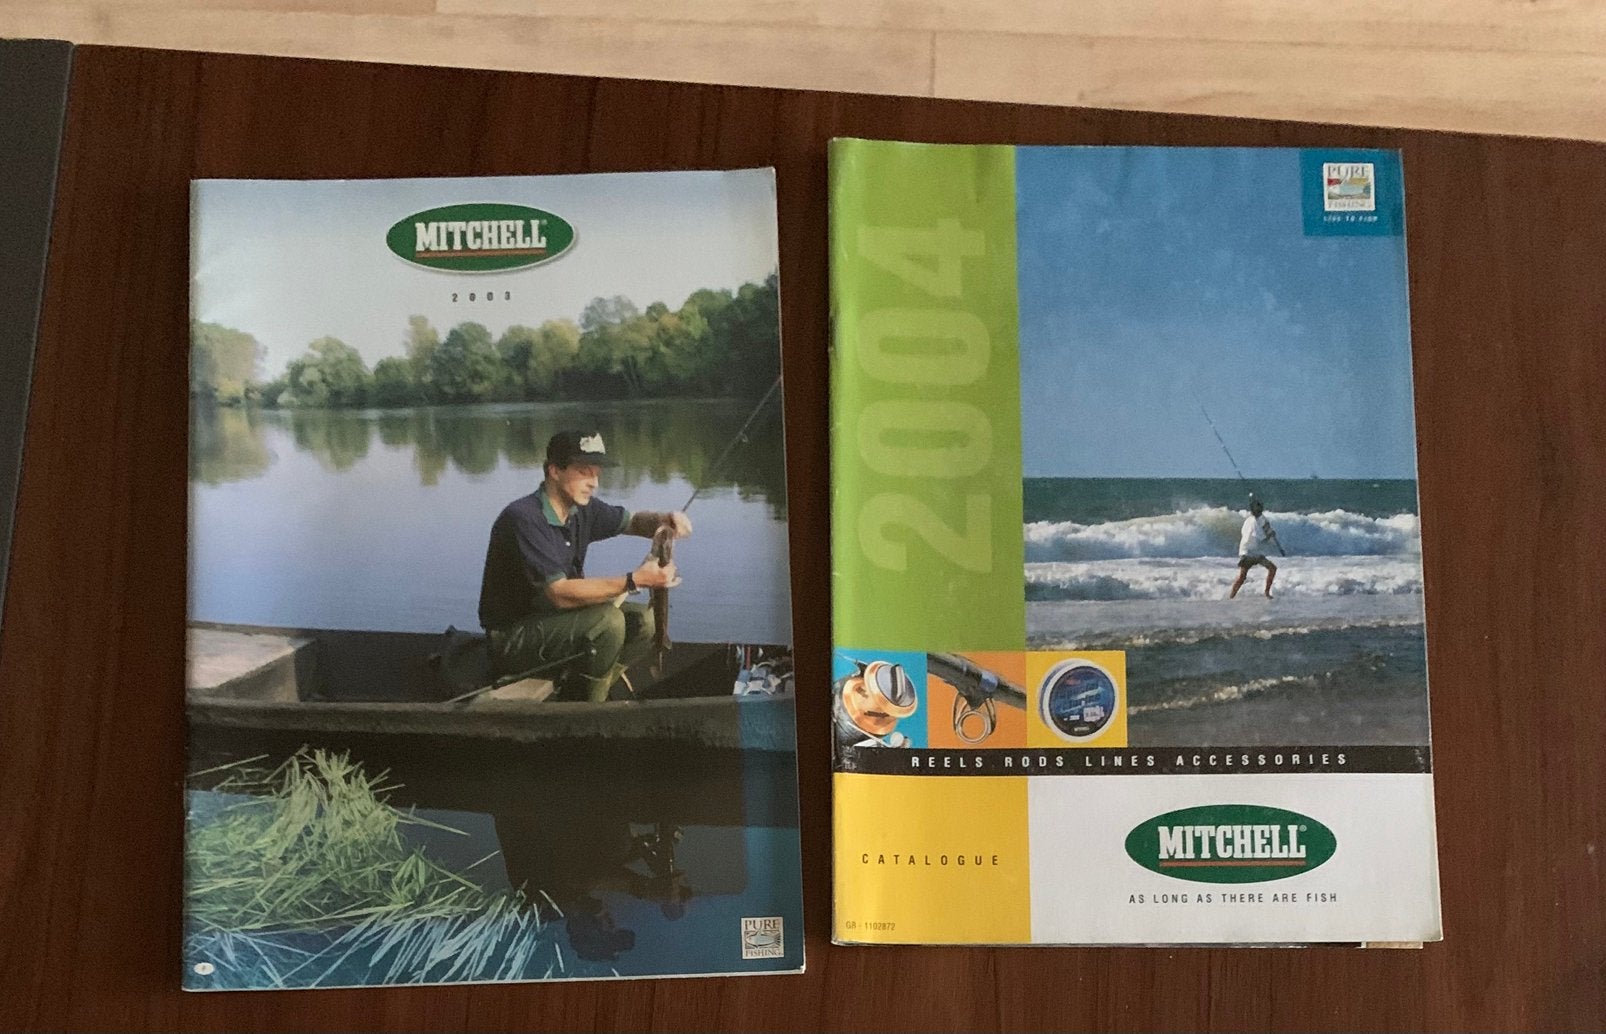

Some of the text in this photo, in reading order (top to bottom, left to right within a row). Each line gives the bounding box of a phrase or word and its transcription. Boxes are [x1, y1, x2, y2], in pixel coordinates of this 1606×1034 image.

[415, 219, 547, 251] MITCHELL
[452, 291, 511, 302] 2003
[857, 218, 993, 575] 2004
[911, 753, 1348, 769] REELS RODS LINES ACCESSORIES
[862, 853, 999, 866] CATALOGUE
[1129, 893, 1337, 904] AS LONG AS THERE ARE FISH
[745, 919, 779, 930] PURE
[746, 949, 781, 957] FISHING
